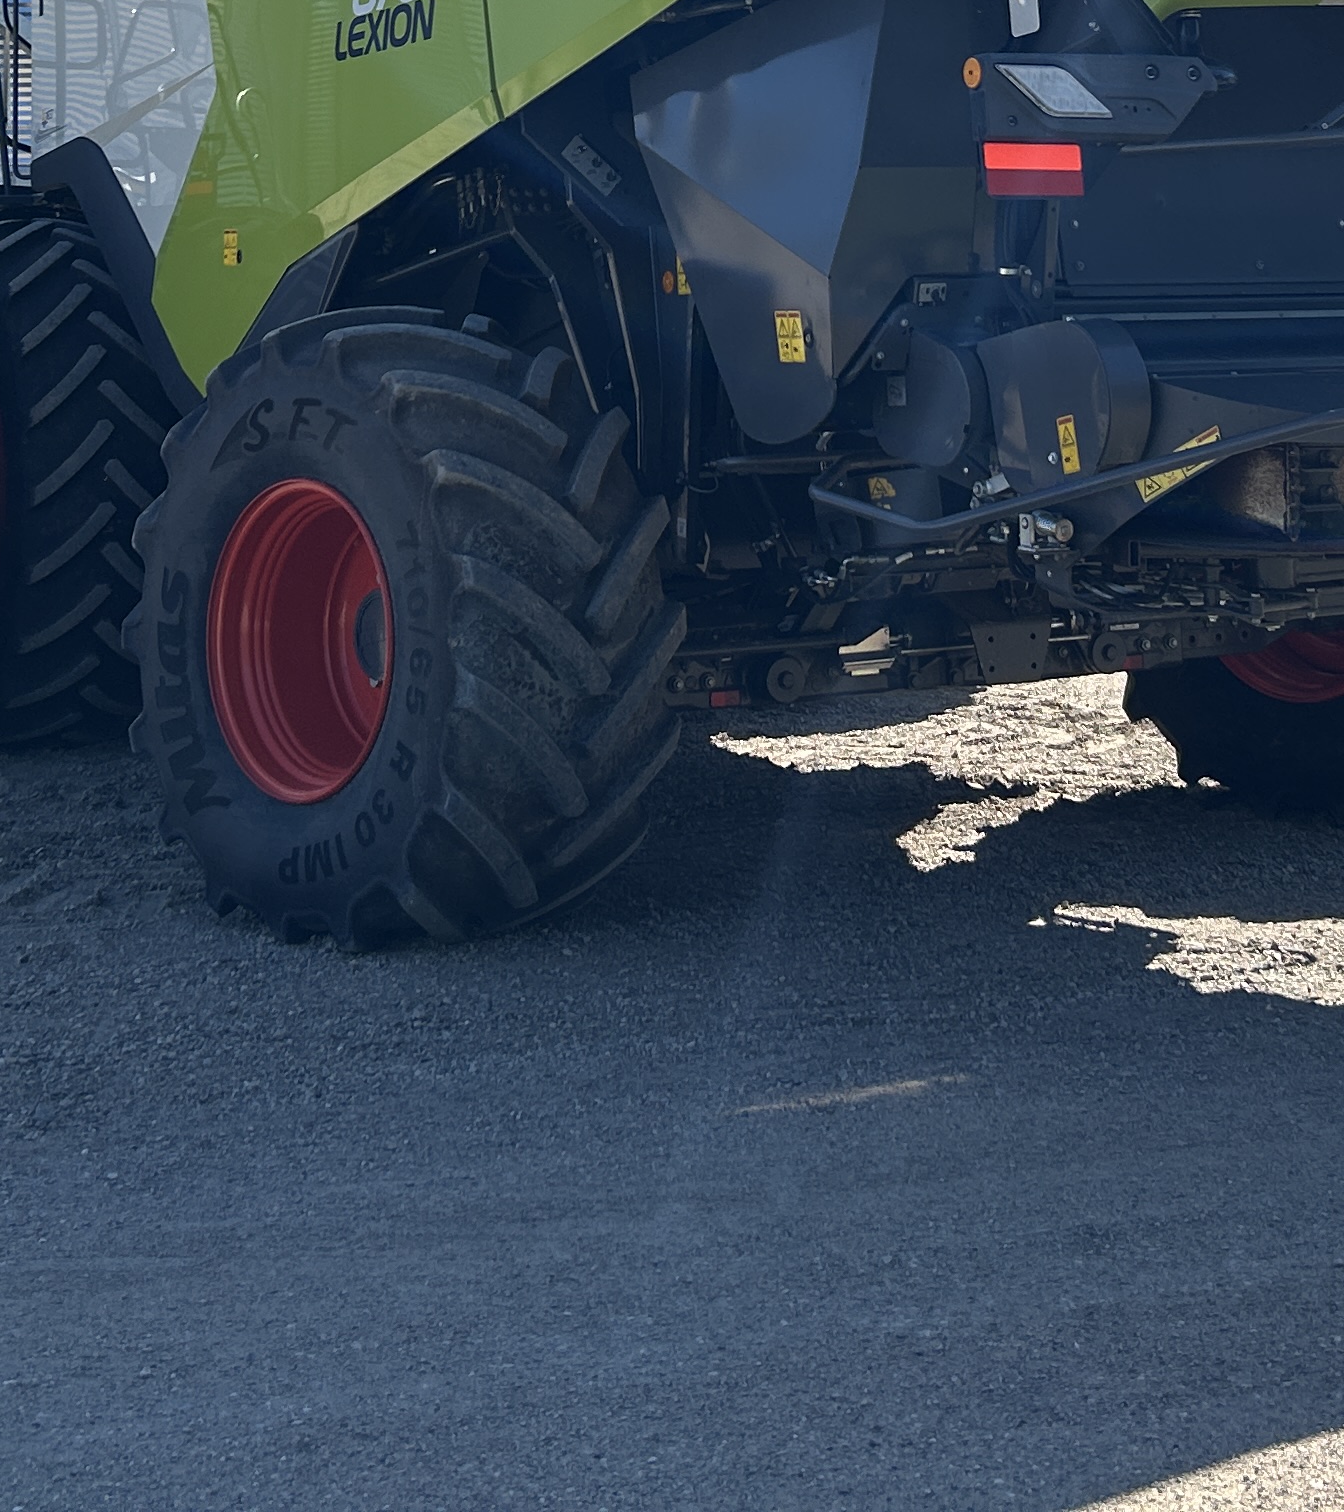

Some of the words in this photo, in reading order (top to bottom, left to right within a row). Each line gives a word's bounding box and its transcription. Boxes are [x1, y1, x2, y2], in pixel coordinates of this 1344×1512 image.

[243, 397, 358, 452] SFT
[354, 788, 394, 848] 30
[278, 831, 349, 884] IMP
